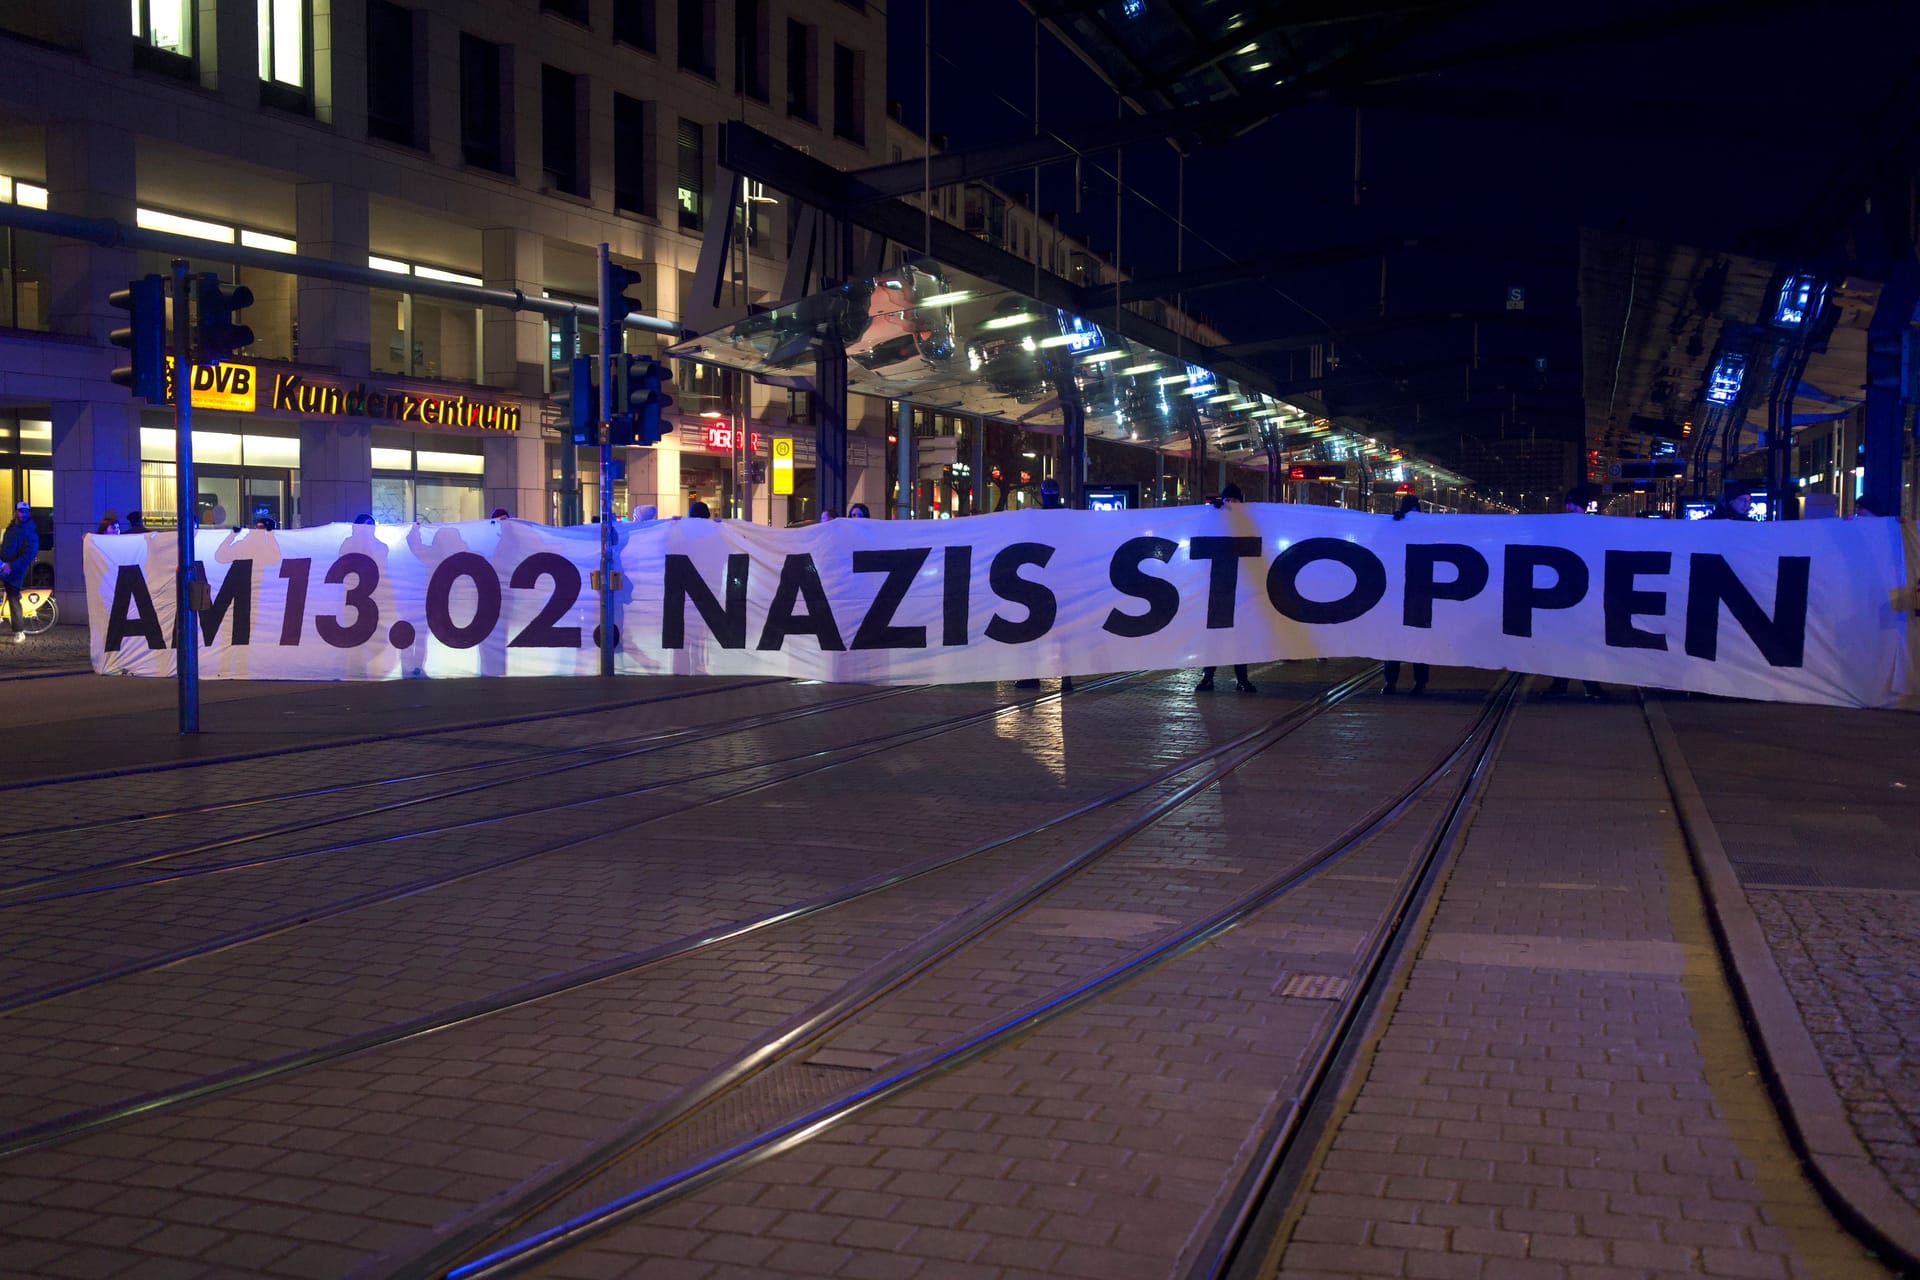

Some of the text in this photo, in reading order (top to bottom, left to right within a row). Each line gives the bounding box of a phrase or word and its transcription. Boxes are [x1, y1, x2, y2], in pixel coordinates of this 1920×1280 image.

[193, 365, 251, 395] DVB
[272, 372, 522, 433] Kundenzentrum
[104, 558, 253, 653] AM
[662, 543, 1057, 652] NAZIS
[1101, 536, 1812, 669] STOPPEN
